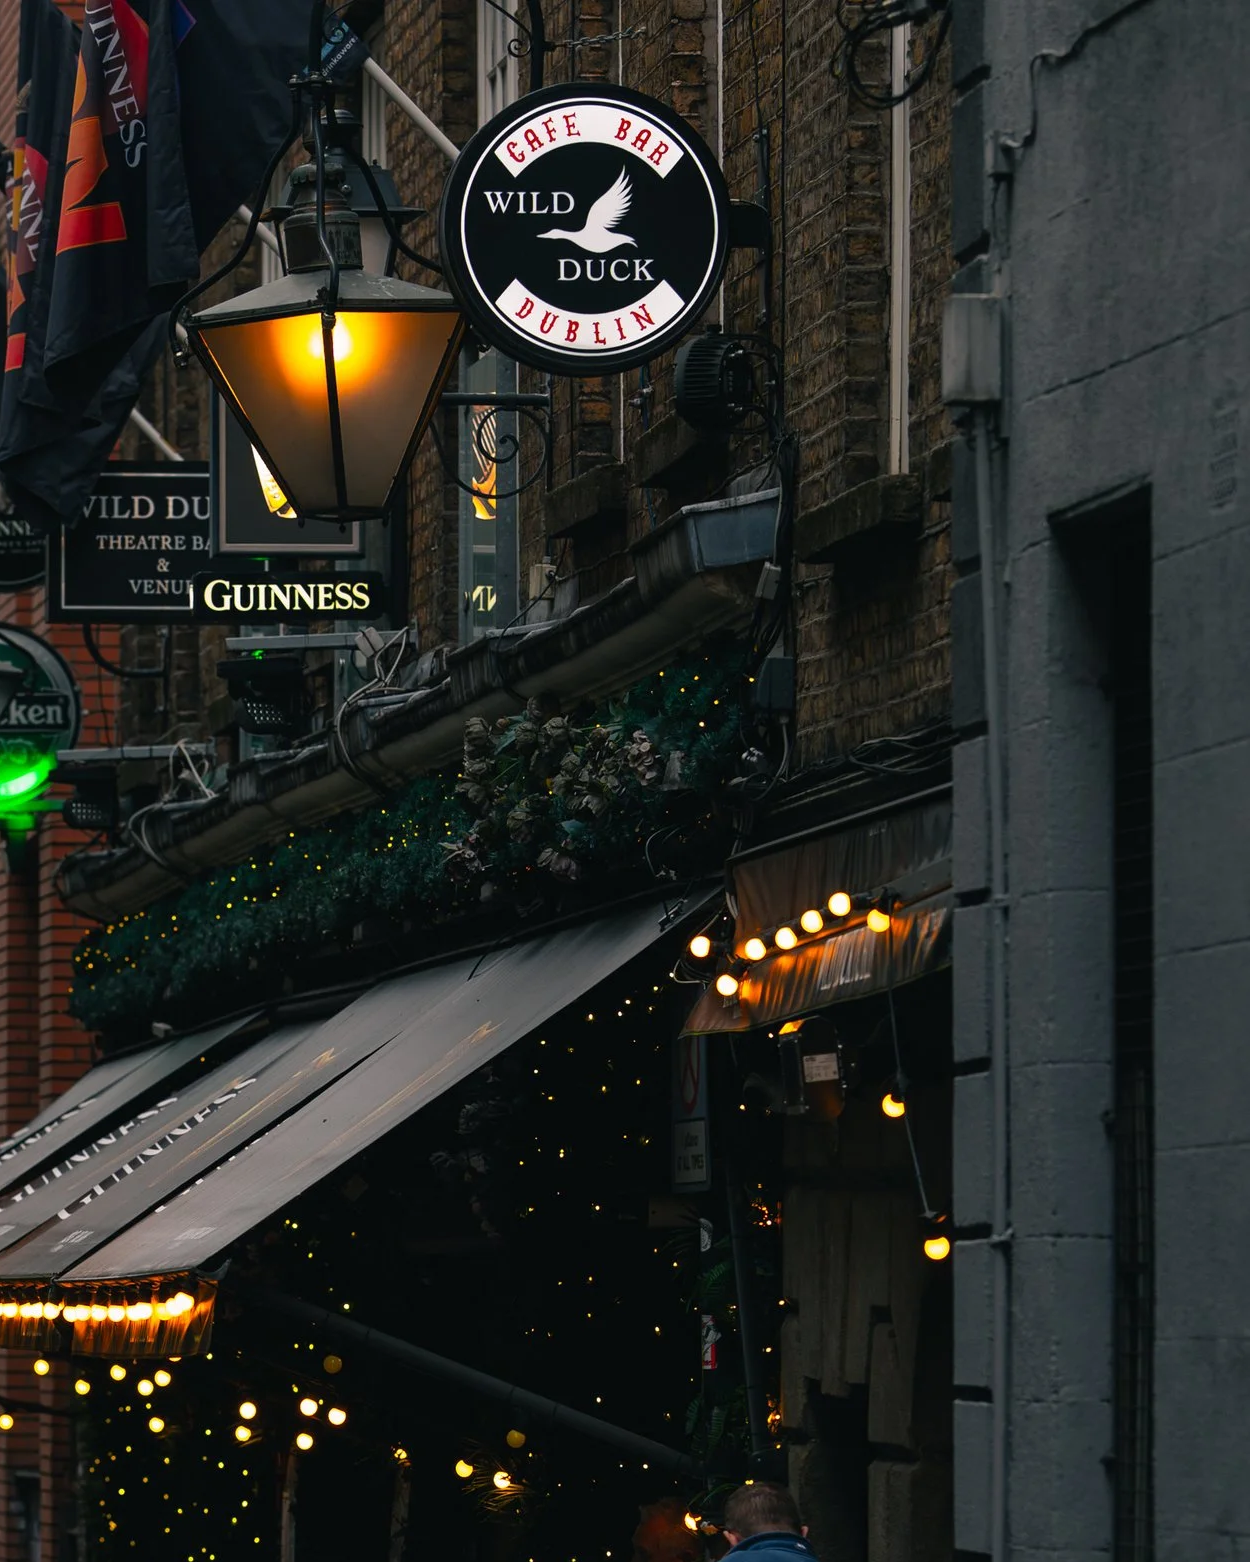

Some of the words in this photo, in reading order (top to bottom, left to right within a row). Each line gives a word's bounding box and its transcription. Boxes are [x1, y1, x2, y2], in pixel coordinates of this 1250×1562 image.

[506, 112, 581, 164] CAFE
[614, 117, 671, 166] BAR
[483, 191, 575, 215] WILD
[557, 258, 655, 282] DUCK
[515, 297, 656, 345] DUBLIN
[96, 534, 186, 550] THEATRE
[156, 557, 171, 573] &
[203, 579, 371, 612] GUINNESS
[0, 698, 63, 726] ken
